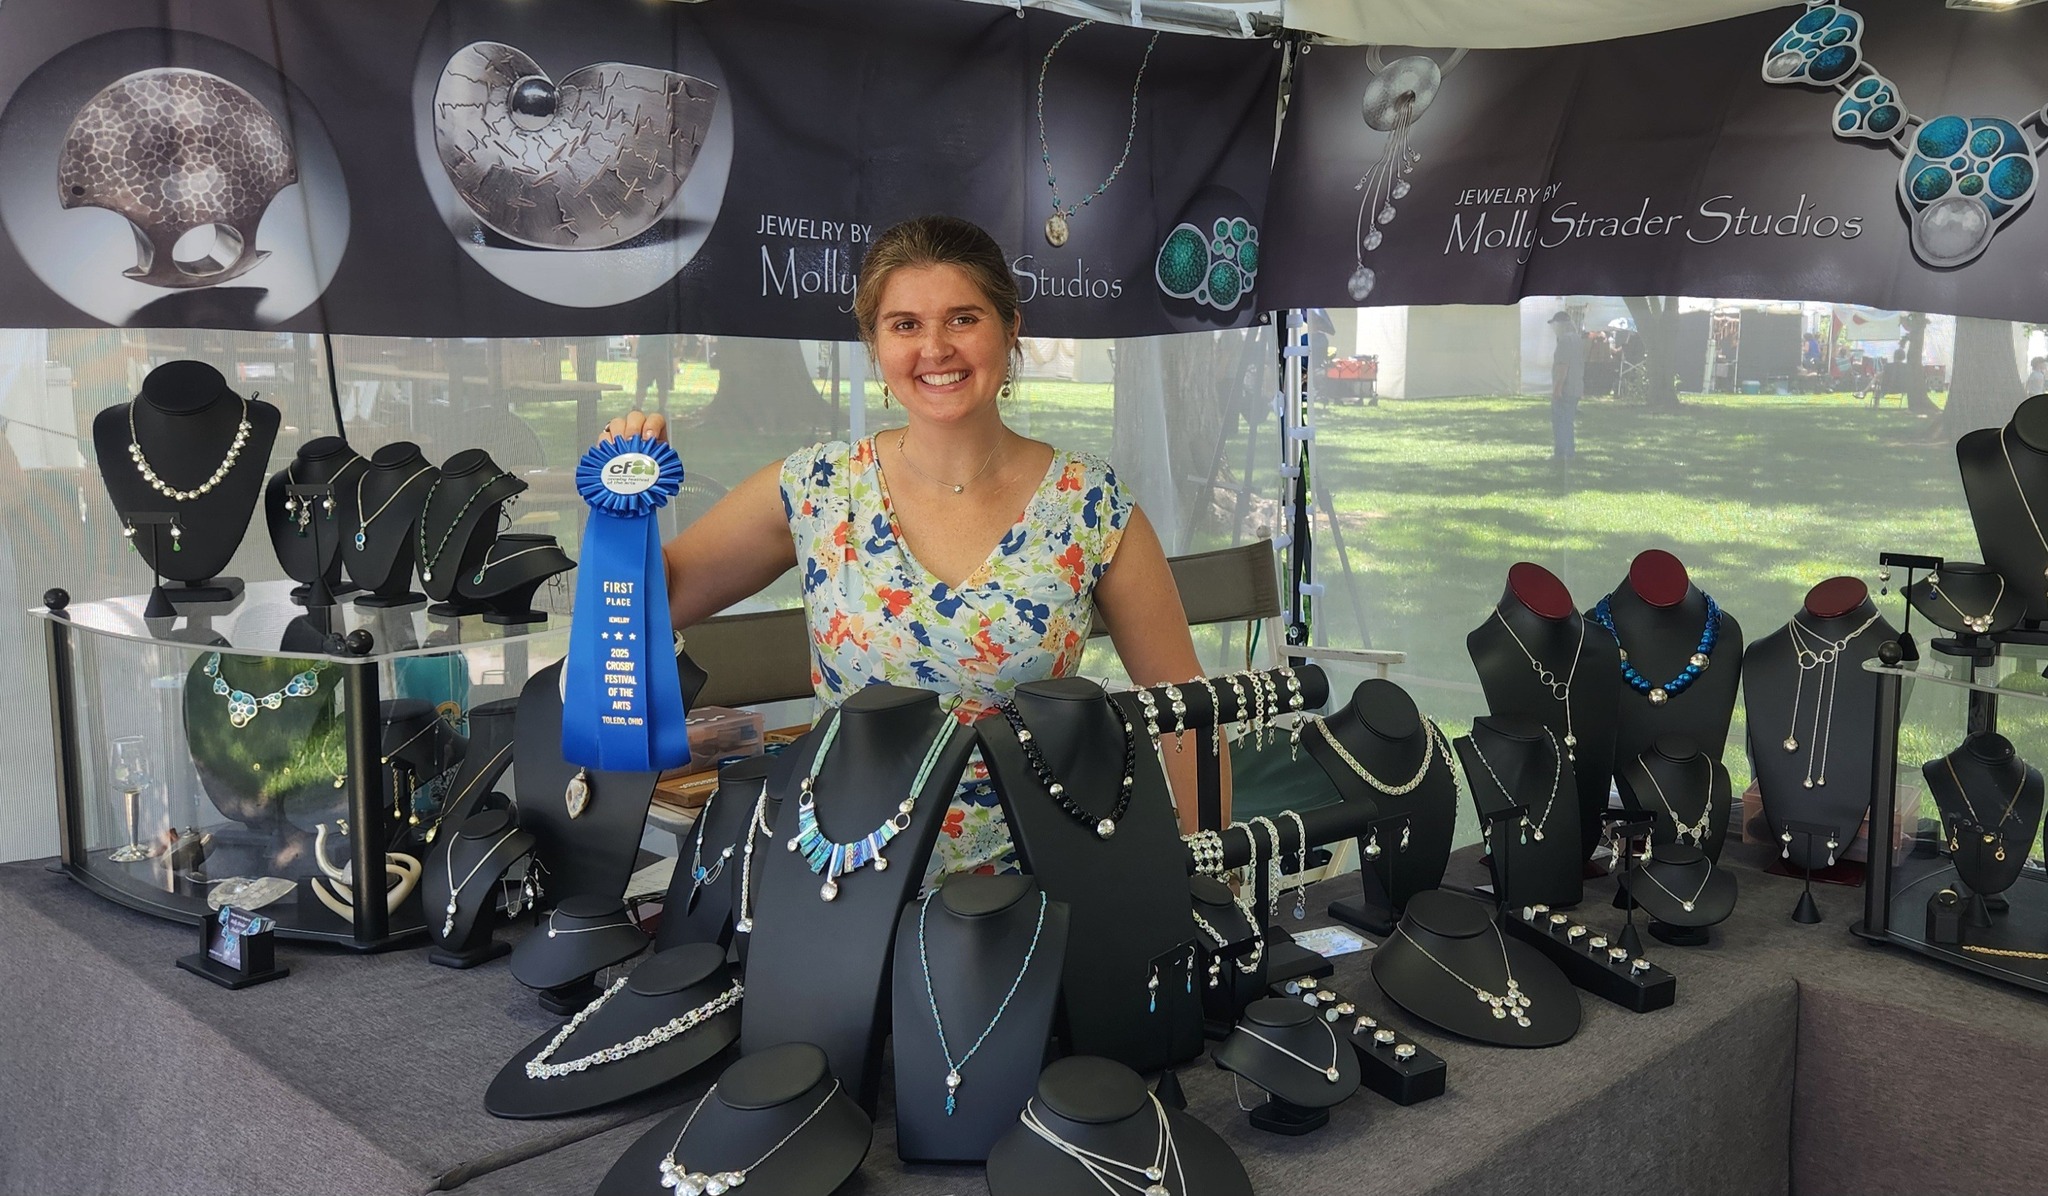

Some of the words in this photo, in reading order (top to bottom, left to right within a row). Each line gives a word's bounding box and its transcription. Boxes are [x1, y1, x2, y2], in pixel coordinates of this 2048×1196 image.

[1454, 187, 1541, 206] JEWELRY
[1542, 181, 1562, 203] BY
[756, 214, 845, 242] JEWELRY
[850, 223, 872, 243] BY
[1443, 208, 1538, 265] Molly
[1539, 197, 1683, 249] Strader
[1685, 193, 1864, 244] Studios
[760, 244, 858, 313] Molly
[1011, 254, 1123, 304] Studios
[603, 580, 634, 594] FIRST
[605, 597, 632, 607] PLACE
[610, 647, 630, 658] 2025
[605, 660, 635, 671] CROSBY
[604, 674, 637, 685] FESTIVAL
[608, 687, 618, 697] OF
[618, 687, 634, 698] THE
[612, 700, 632, 711] ARTS
[601, 715, 627, 726] TOLEDO,
[627, 717, 644, 726] OHIO
